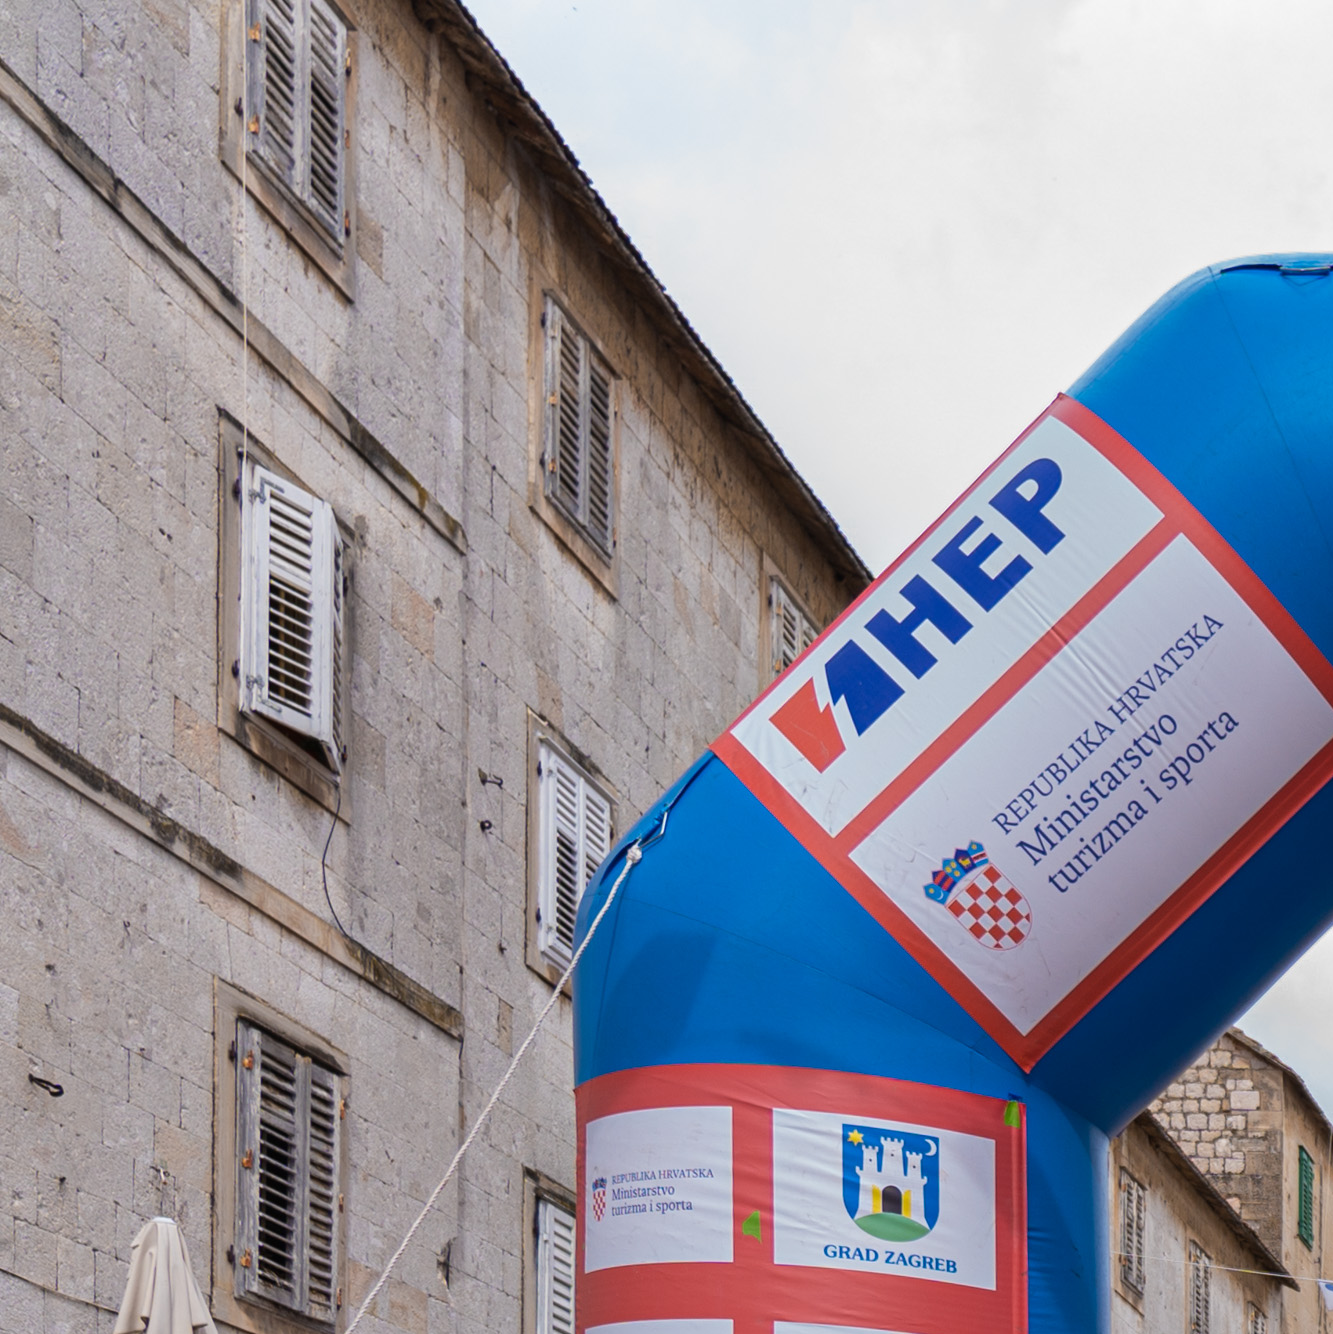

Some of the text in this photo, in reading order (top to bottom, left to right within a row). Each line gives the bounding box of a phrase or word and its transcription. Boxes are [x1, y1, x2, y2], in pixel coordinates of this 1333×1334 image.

[864, 457, 1066, 681] HEP
[991, 614, 1225, 835] REPUBLIKA HRVATSKA
[1015, 713, 1178, 867] Ministarstvo
[1048, 711, 1240, 893] turizma i sporta
[612, 1168, 714, 1185] REPUBLIKA HRVATSKA
[612, 1186, 675, 1201] Ministarstvo
[612, 1202, 647, 1216] turizma
[656, 1200, 693, 1214] sporta
[823, 1244, 958, 1274] GRAD ZAGREB
